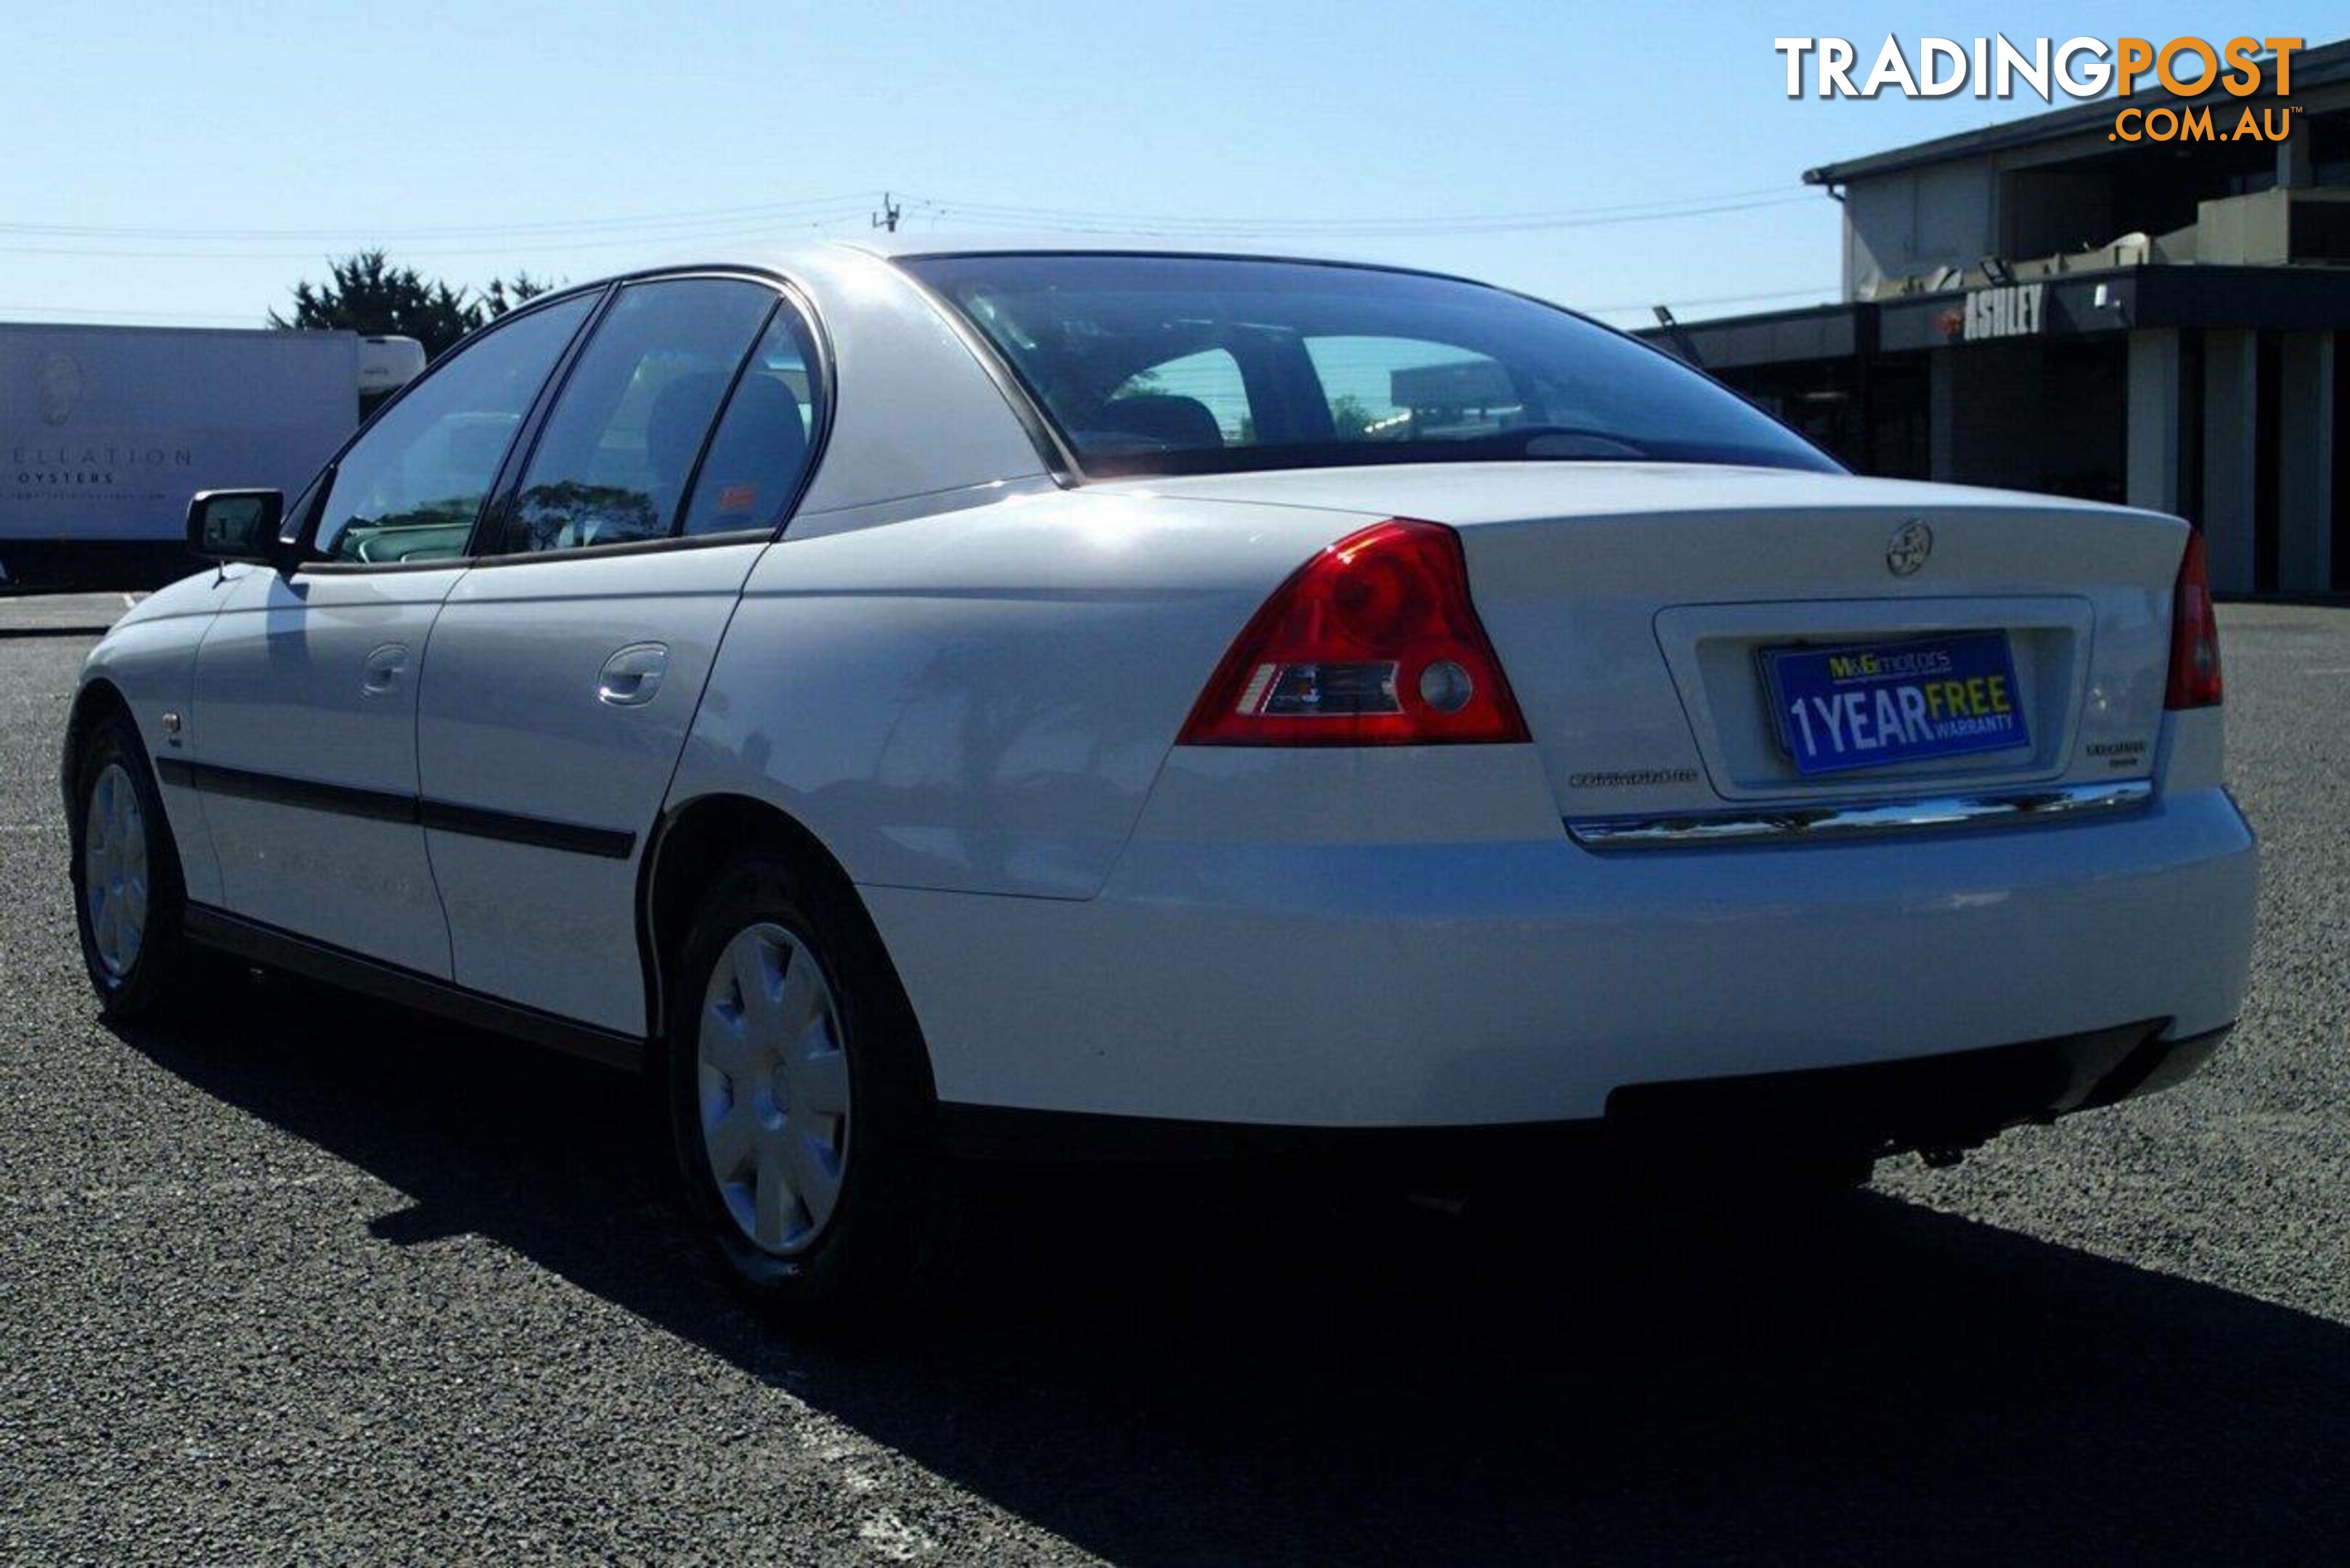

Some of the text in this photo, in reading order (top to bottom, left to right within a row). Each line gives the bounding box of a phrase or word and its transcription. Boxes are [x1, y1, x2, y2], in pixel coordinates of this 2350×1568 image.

[1964, 284, 2041, 340] ASHLEY
[17, 471, 113, 484] OYSTERS
[1925, 675, 2011, 720] FREE
[1935, 714, 2013, 739] WARRANTY
